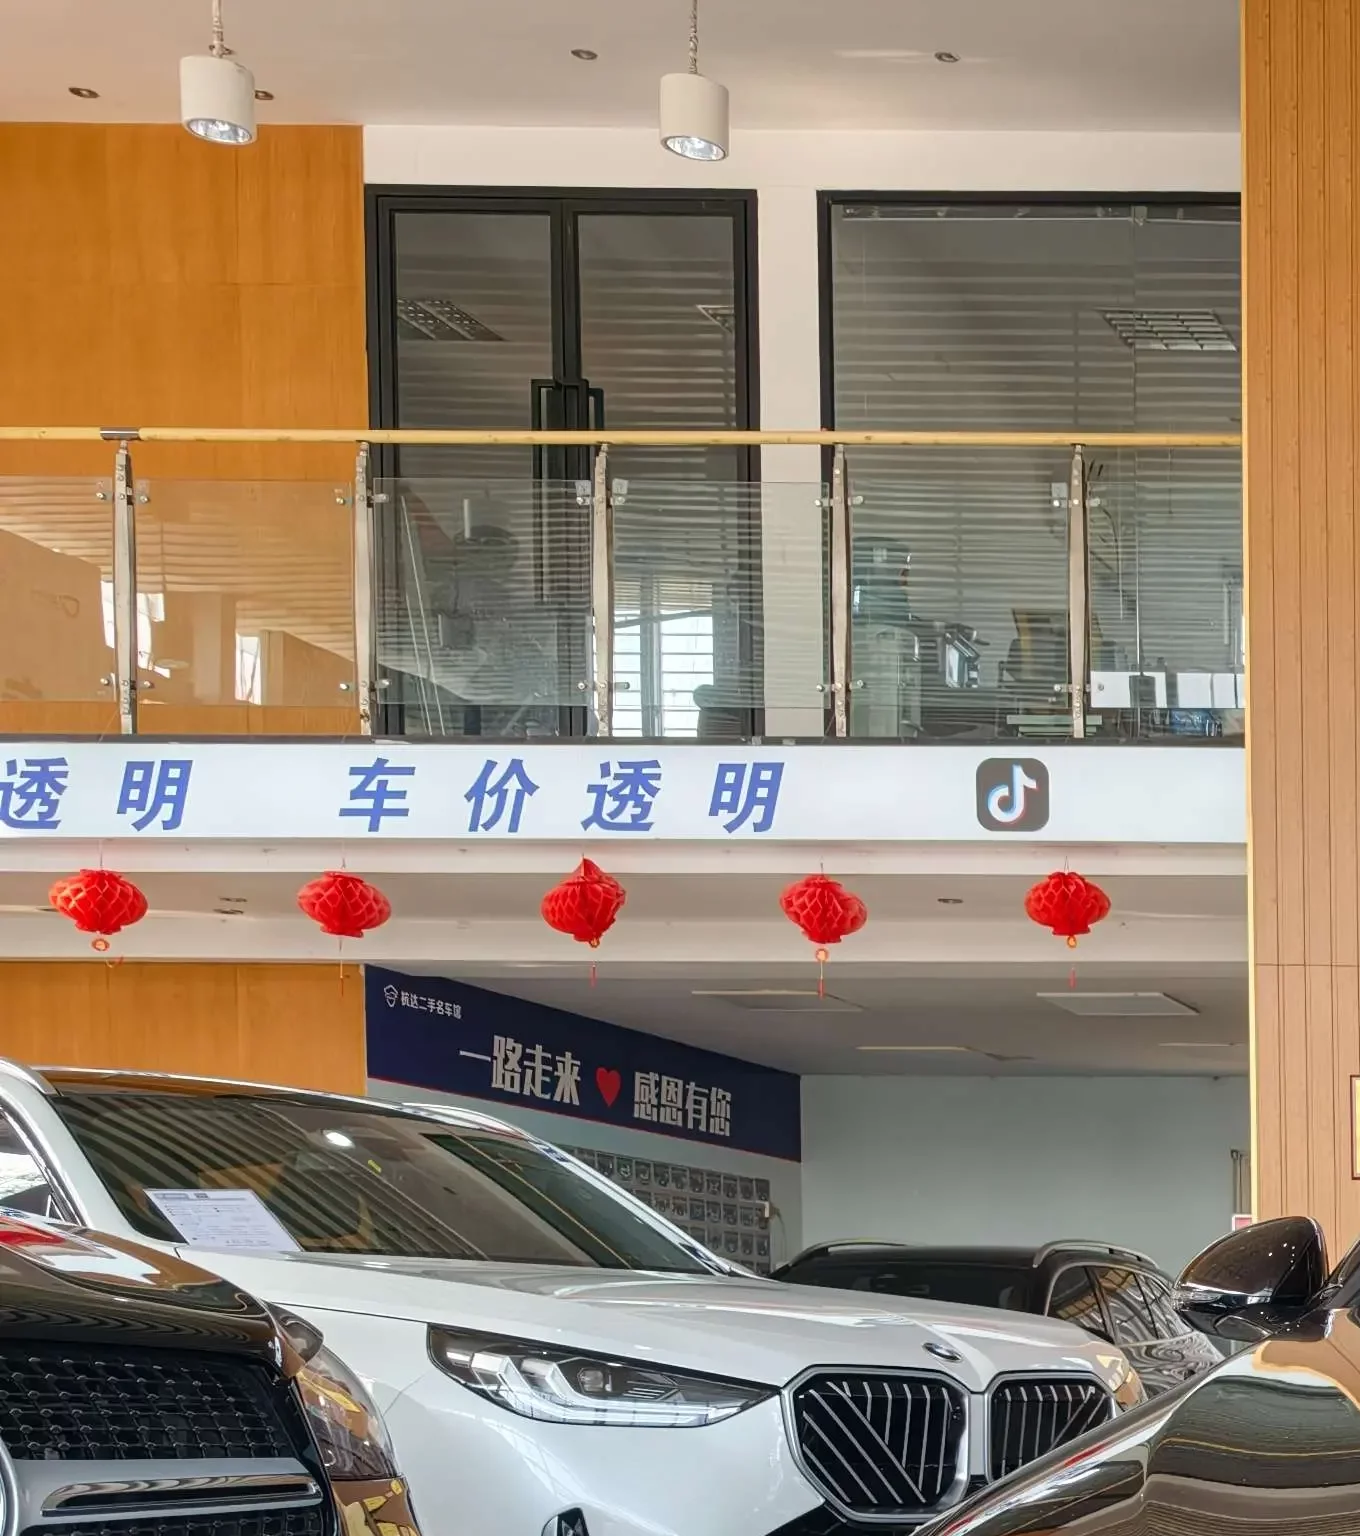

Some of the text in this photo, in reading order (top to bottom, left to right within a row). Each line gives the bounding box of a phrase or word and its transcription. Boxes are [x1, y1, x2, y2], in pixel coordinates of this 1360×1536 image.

[340, 759, 783, 832] 车价透明
[401, 990, 462, 1019] 杭达二手名车馆
[459, 1034, 732, 1137] 一路走来 感恩有您
